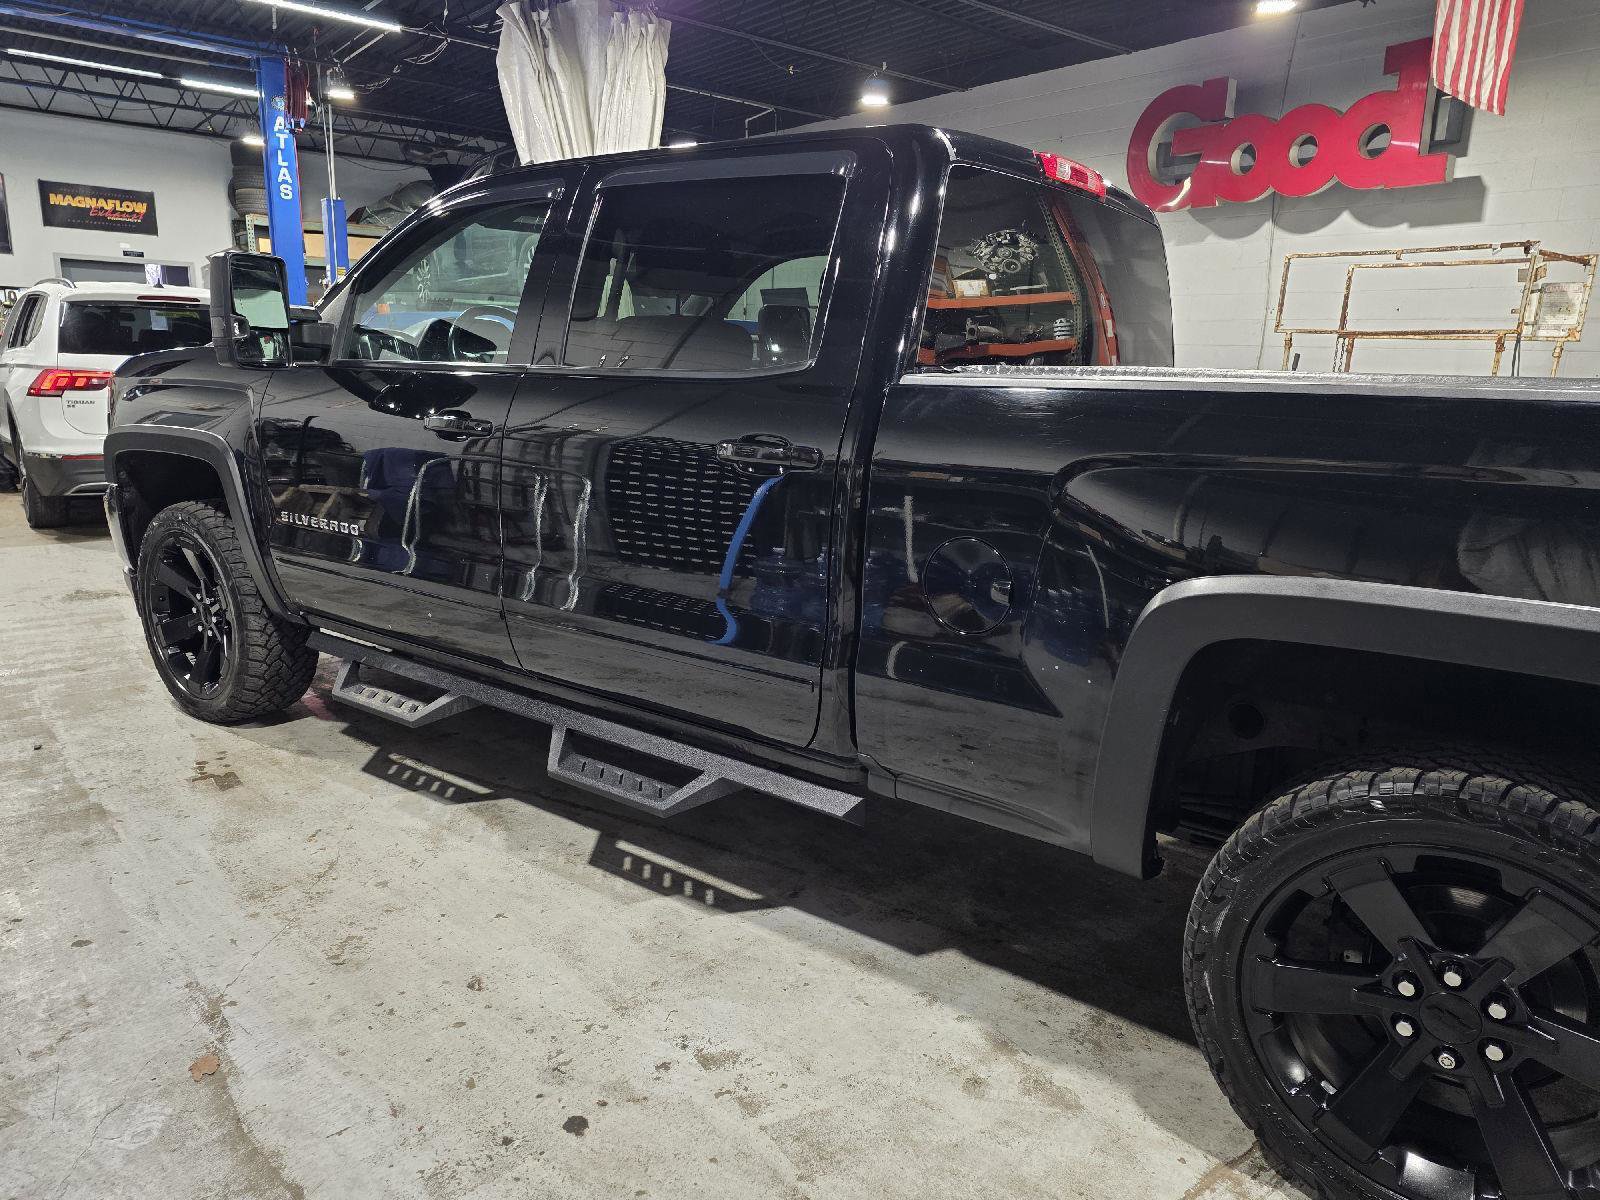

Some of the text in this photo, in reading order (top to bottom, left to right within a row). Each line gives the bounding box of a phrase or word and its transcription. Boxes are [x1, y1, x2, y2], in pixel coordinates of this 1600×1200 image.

[1127, 37, 1452, 213] Good
[273, 115, 293, 200] ATLAS
[49, 193, 148, 213] MAGNAFLOW
[280, 511, 359, 536] SILVERADO
